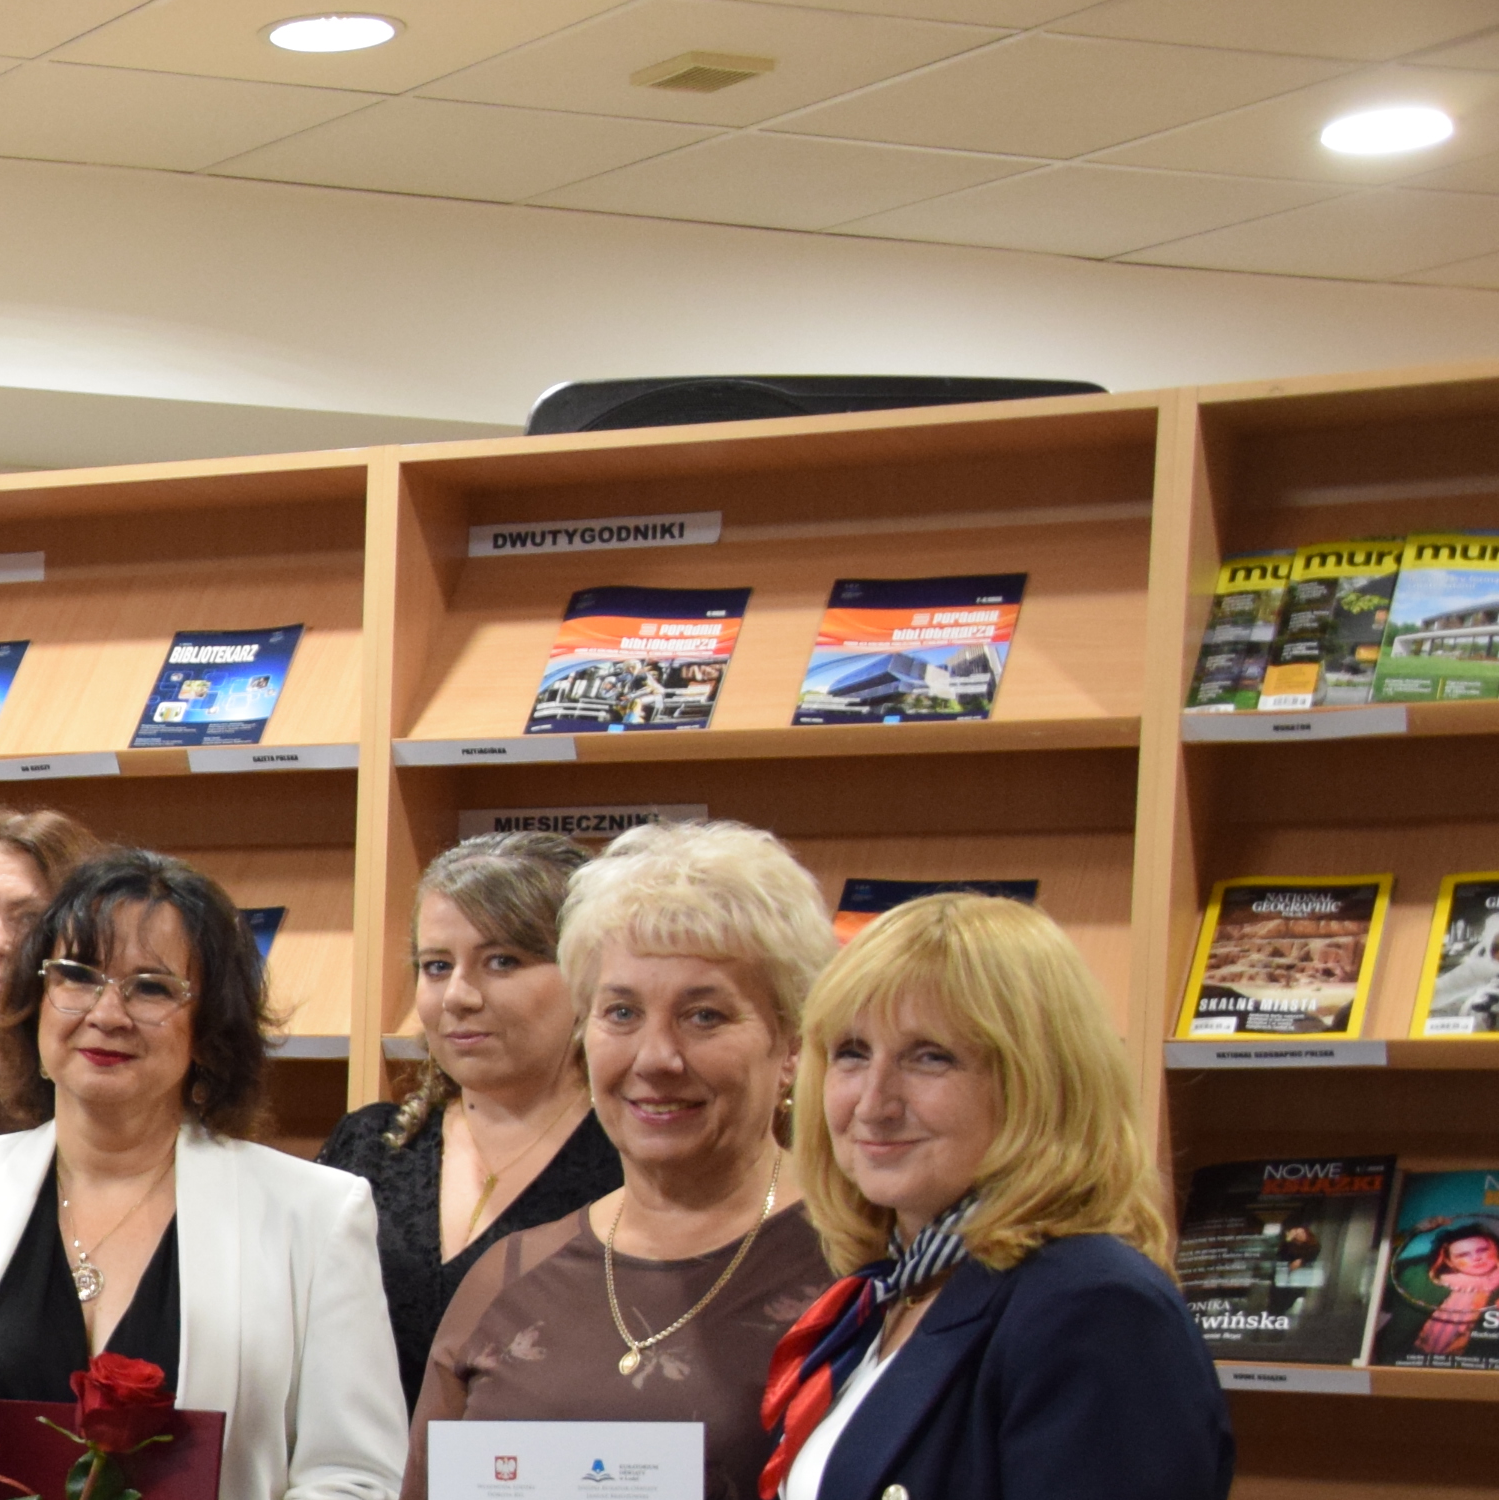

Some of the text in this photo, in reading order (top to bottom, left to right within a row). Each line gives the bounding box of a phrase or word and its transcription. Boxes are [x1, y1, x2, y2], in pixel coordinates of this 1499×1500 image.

[492, 521, 686, 549] DWUTYGODNIKI
[169, 644, 259, 665] BIBLIOTEKARZ
[1252, 901, 1341, 913] GEOGRAPHIC
[1199, 997, 1318, 1012] SKALNE MIASTA
[1264, 1162, 1342, 1179] NOWE
[1195, 1311, 1290, 1330] iwińska
